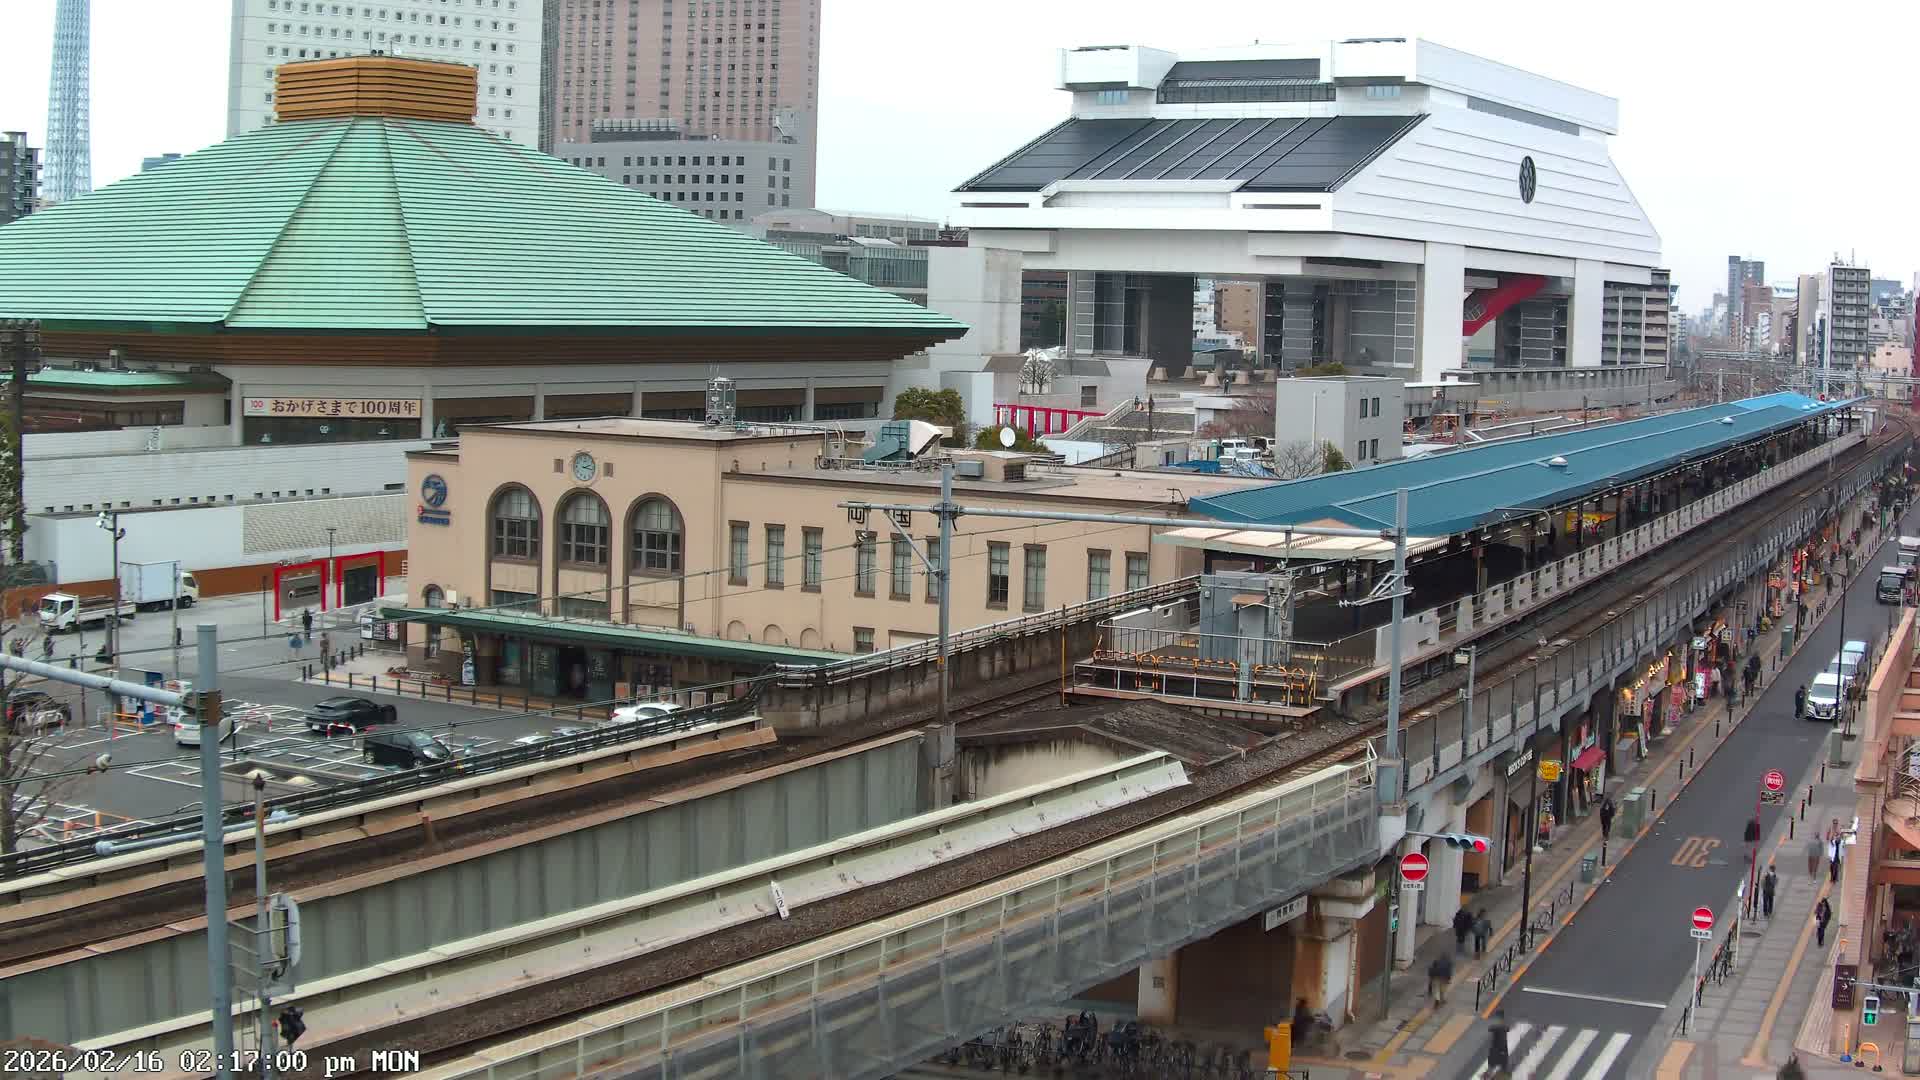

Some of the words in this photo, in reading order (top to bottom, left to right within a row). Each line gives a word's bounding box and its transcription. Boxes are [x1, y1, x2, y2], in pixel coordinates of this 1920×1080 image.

[271, 400, 417, 416] おかげさまで100周年
